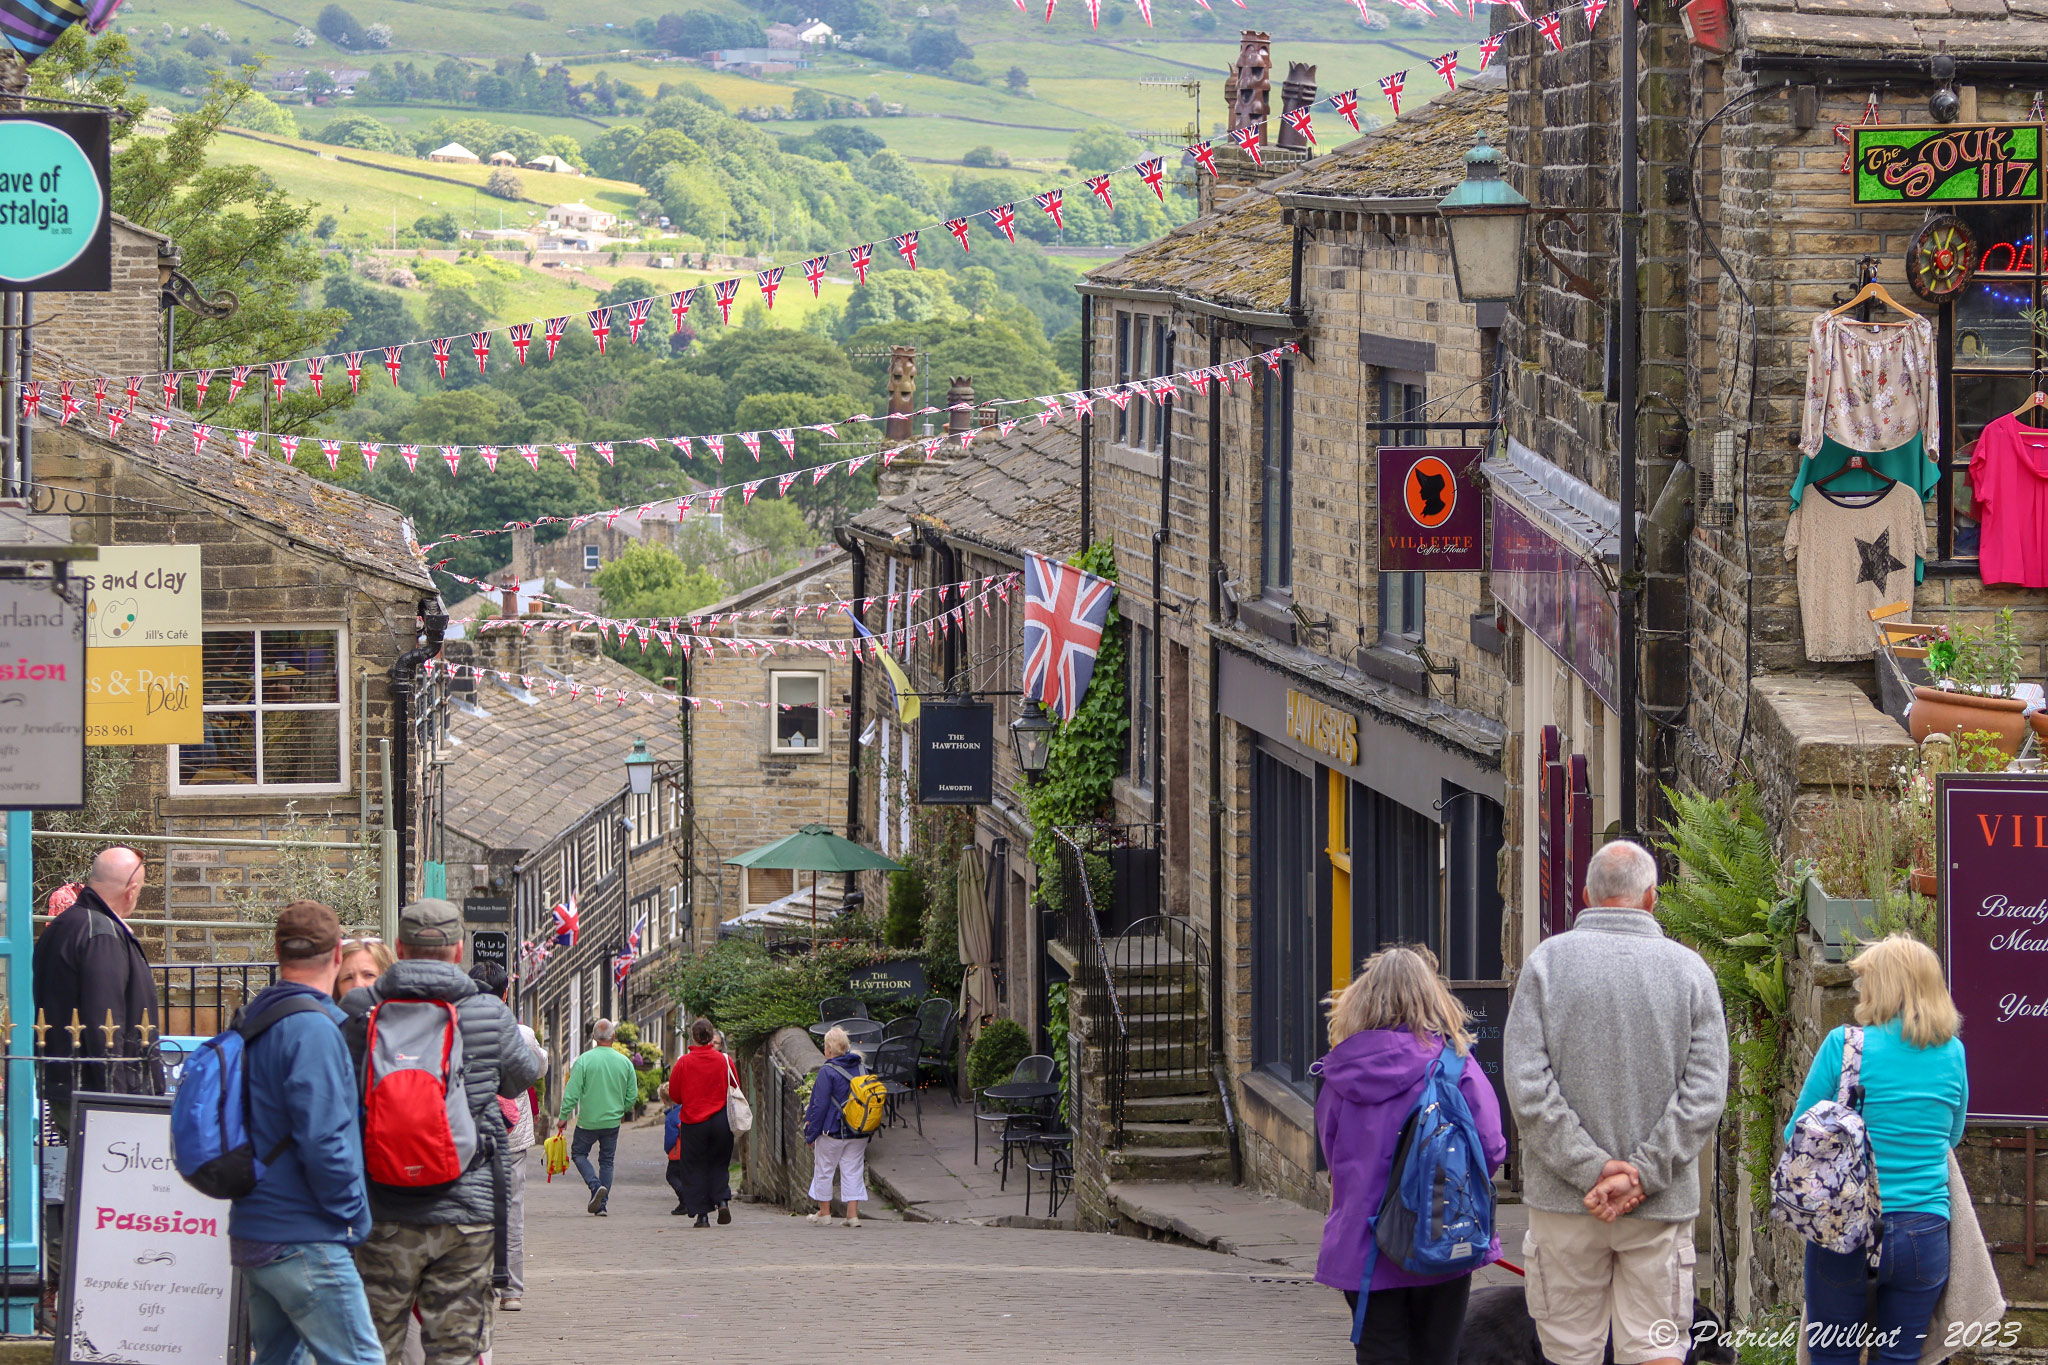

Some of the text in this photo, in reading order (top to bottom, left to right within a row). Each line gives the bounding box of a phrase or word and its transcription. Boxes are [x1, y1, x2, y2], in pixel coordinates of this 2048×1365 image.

[40, 165, 62, 193] of
[1980, 162, 2034, 198] 117
[1388, 535, 1474, 548] VILLETTE
[1416, 543, 1469, 556] Coffee House
[102, 570, 138, 591] and
[144, 567, 188, 595] clay
[145, 629, 189, 641] Jill's Café
[107, 670, 132, 696] &
[137, 669, 190, 692] Pots
[146, 682, 190, 716] Deli
[85, 723, 135, 737] 958 961
[948, 734, 965, 742] THE
[931, 741, 982, 751] HAWTHORN
[938, 784, 973, 792] HAWORTH
[1977, 813, 2048, 848] VIL
[475, 940, 486, 949] Oh
[477, 950, 504, 958] Vintage
[870, 971, 888, 980] THE
[1996, 992, 2048, 1024] York
[95, 1206, 218, 1237] Passion
[83, 1277, 224, 1299] Bespoke Silver Jewellery
[138, 1302, 166, 1316] Gifts
[142, 1323, 160, 1333] and
[117, 1339, 183, 1354] Accessories
